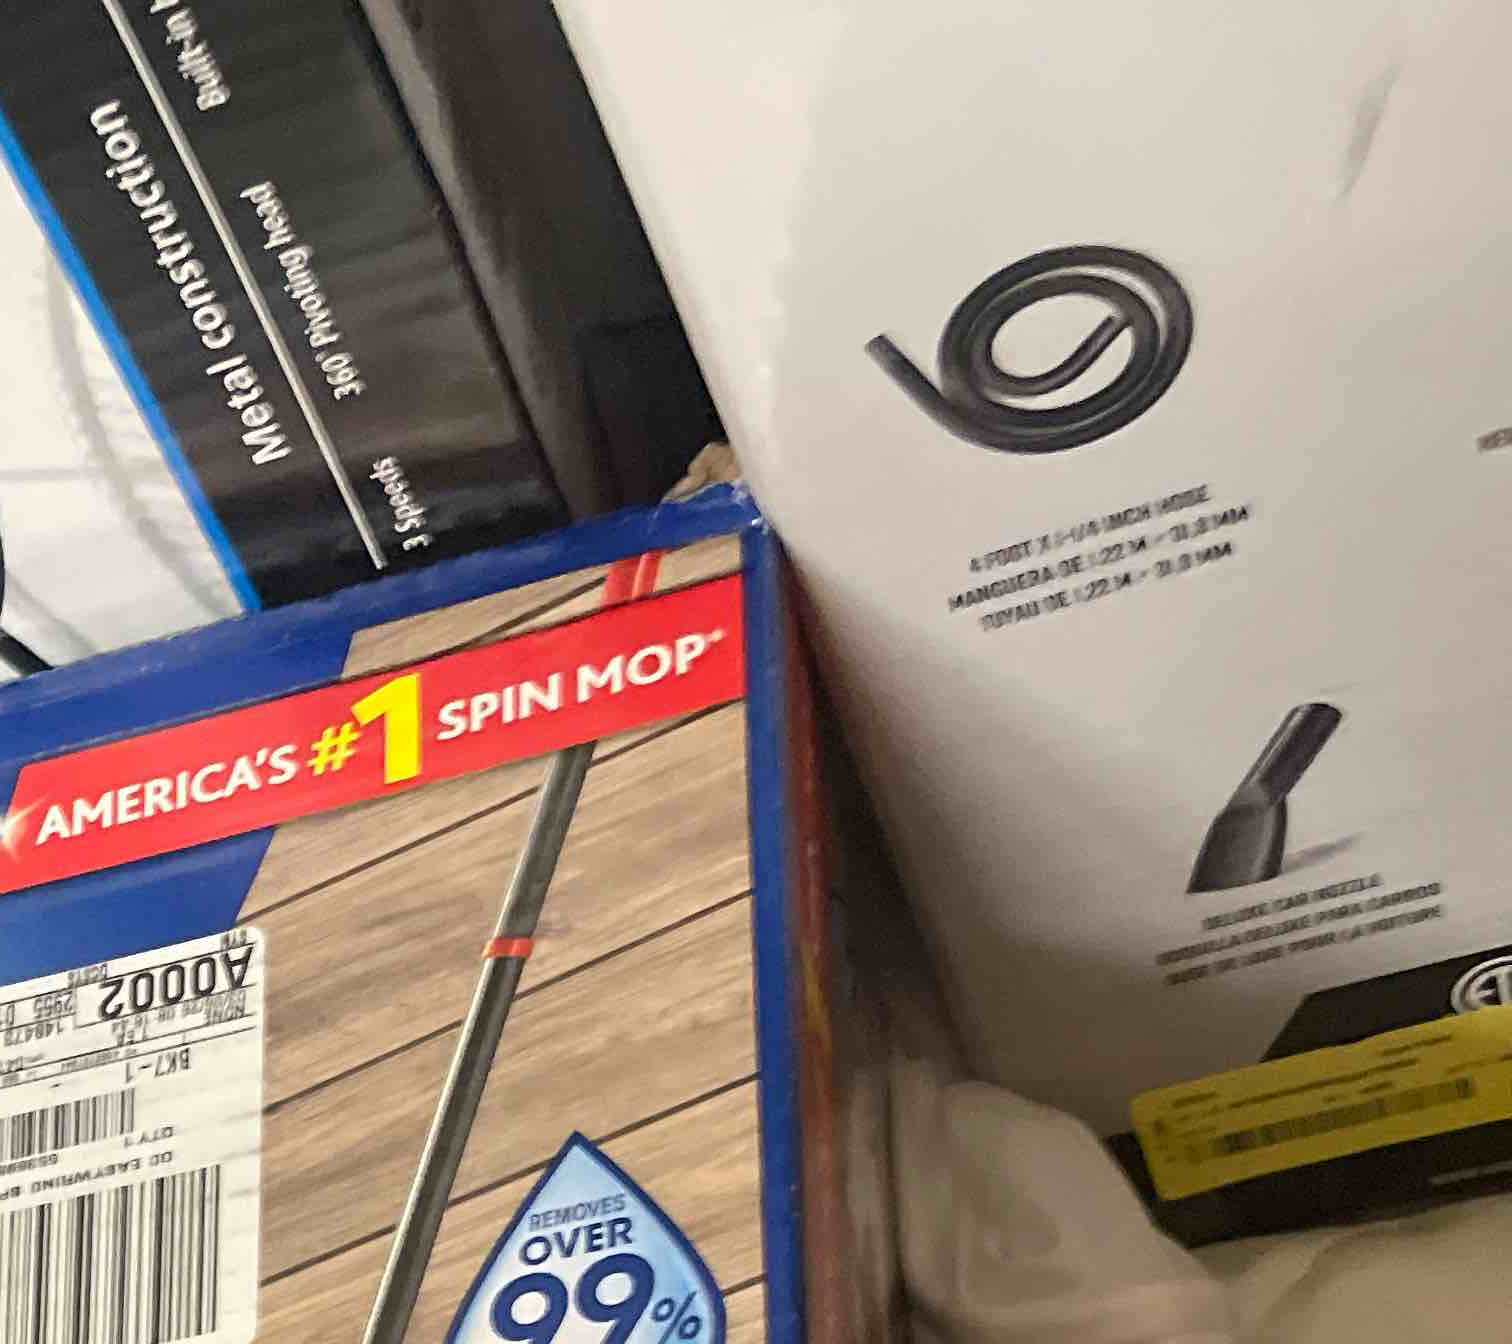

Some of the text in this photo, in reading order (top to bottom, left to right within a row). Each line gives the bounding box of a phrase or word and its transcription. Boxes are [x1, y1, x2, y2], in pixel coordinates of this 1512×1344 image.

[239, 180, 298, 250] head
[89, 99, 292, 466] Metal construction
[282, 246, 345, 353] Pivoting
[369, 456, 434, 552] 3 Speeds
[34, 743, 300, 846] AMERICA'S
[308, 673, 422, 786] #1
[436, 672, 563, 742] SPIN
[98, 945, 253, 1020] A0002
[520, 1217, 634, 1266] OVER
[529, 1194, 627, 1231] REMOVES
